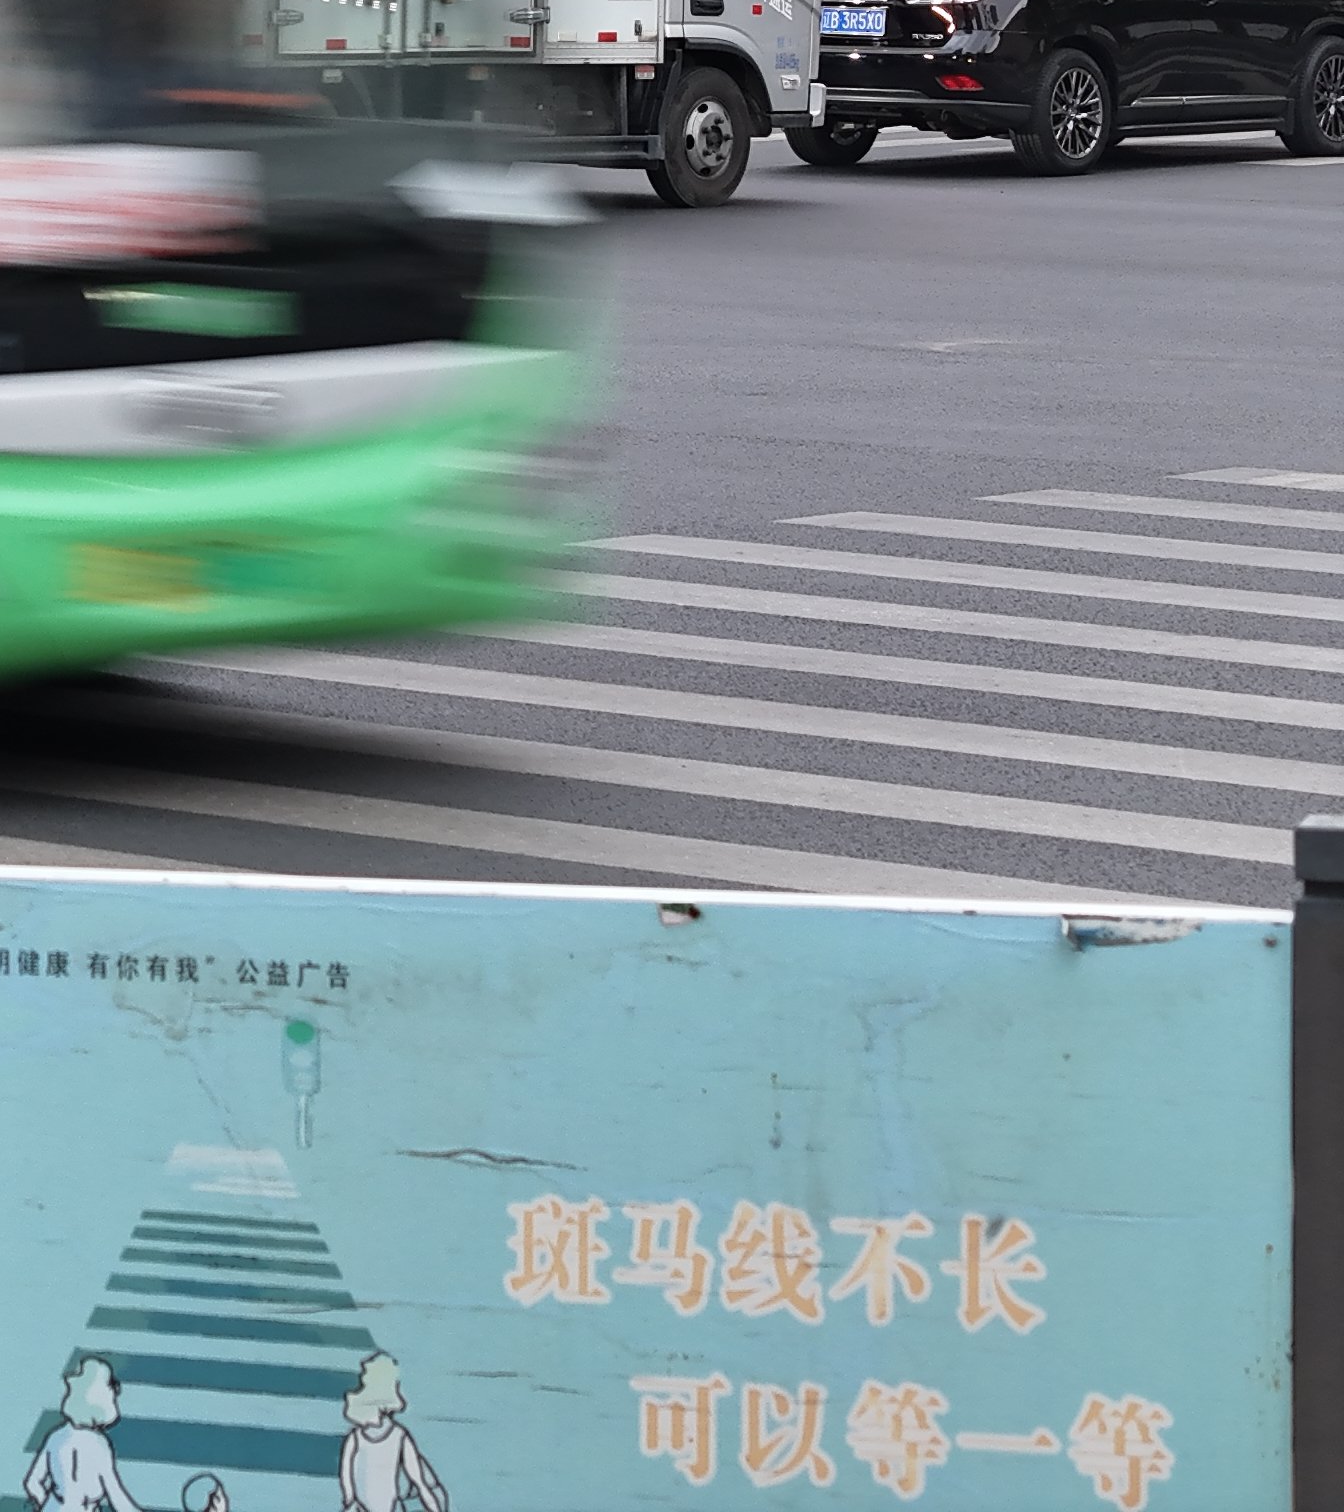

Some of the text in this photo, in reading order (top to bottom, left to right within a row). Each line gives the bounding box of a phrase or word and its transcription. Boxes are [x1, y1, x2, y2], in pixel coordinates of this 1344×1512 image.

[236, 958, 352, 989] 公益广告
[506, 1196, 1046, 1331] 斑马线不长
[632, 1371, 1174, 1509] 可以等一等
